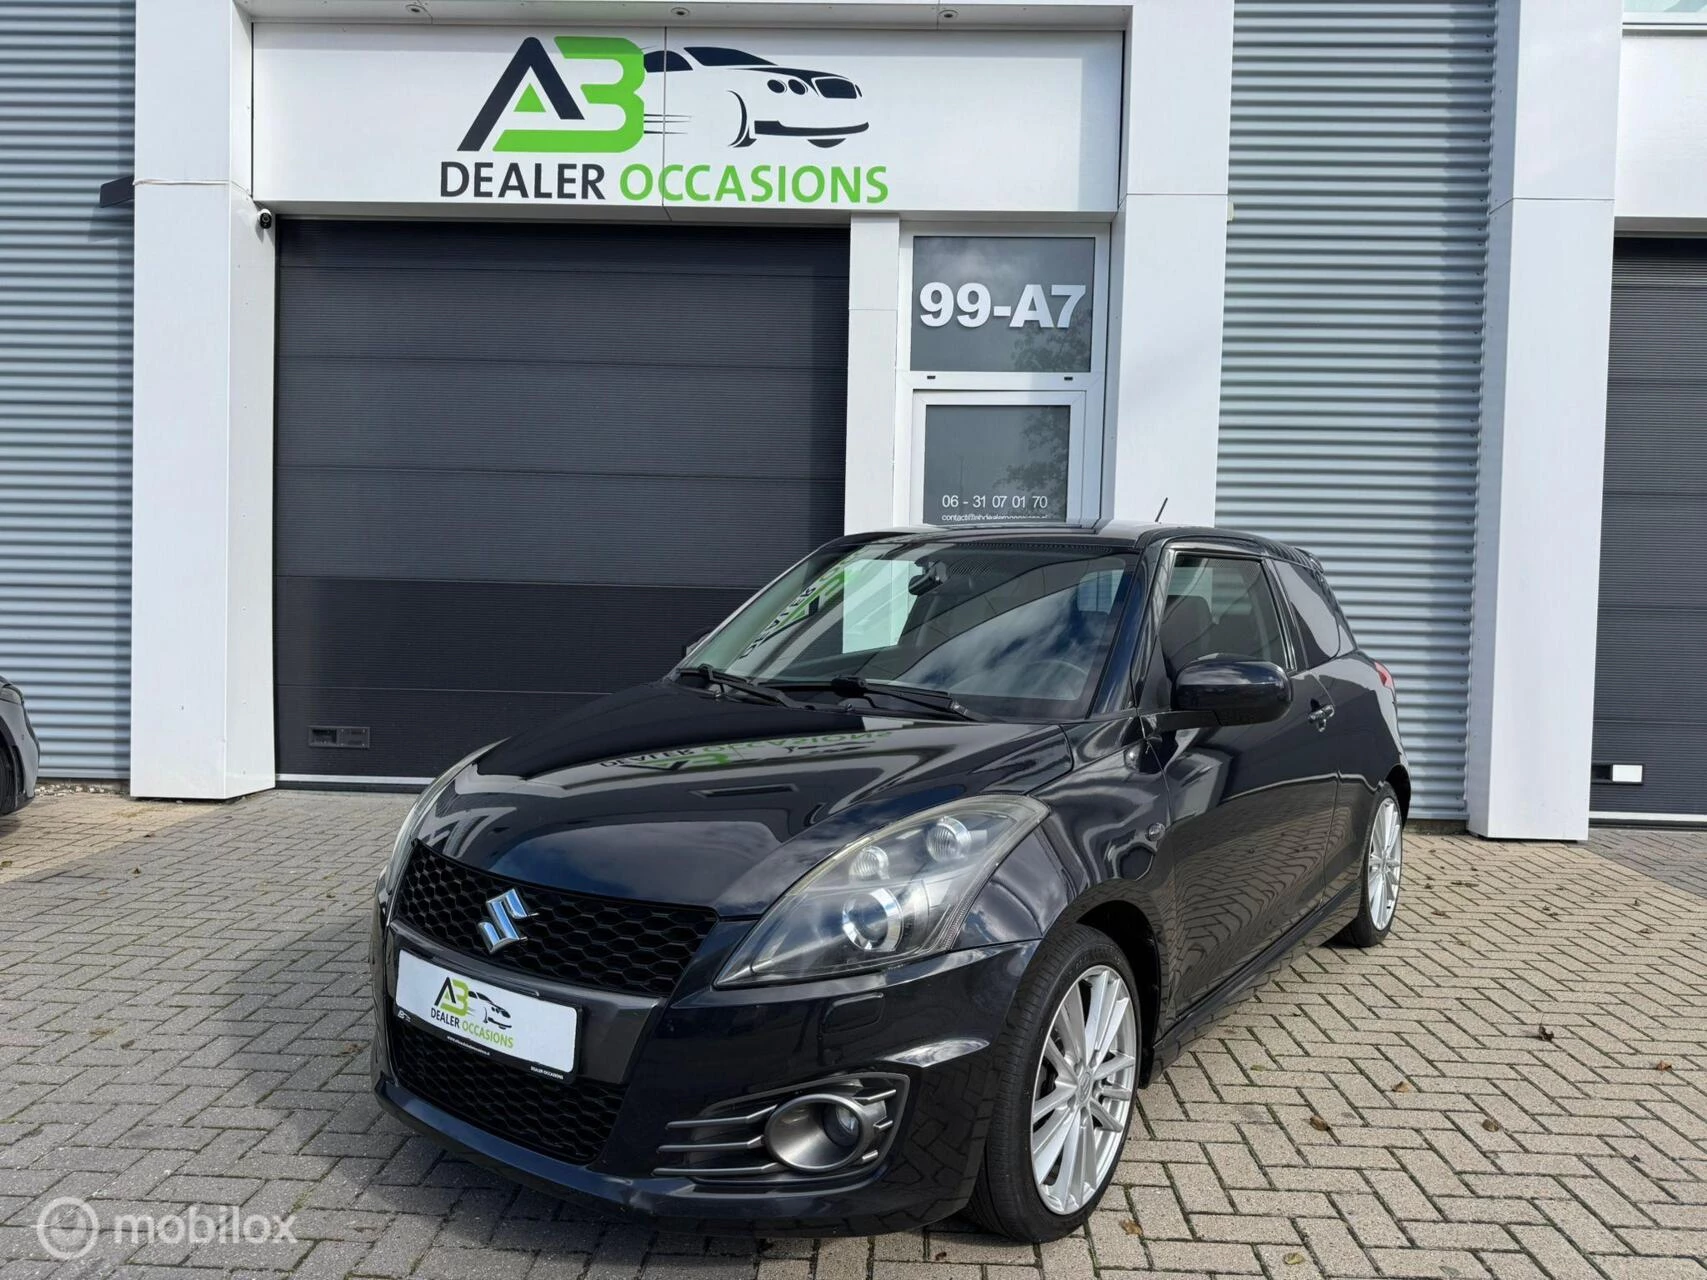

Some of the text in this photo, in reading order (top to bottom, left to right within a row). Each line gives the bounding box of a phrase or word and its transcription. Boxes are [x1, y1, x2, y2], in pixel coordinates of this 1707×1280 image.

[440, 161, 889, 204] DEALER OCCASIONS
[919, 281, 1087, 328] 99-A7
[942, 494, 959, 508] 06
[972, 495, 986, 508] 31
[992, 495, 1007, 508] 07
[1012, 495, 1026, 508] 01
[1032, 496, 1048, 508] 70
[431, 1007, 460, 1028] DEALER
[462, 1021, 514, 1049] OCCASIONS
